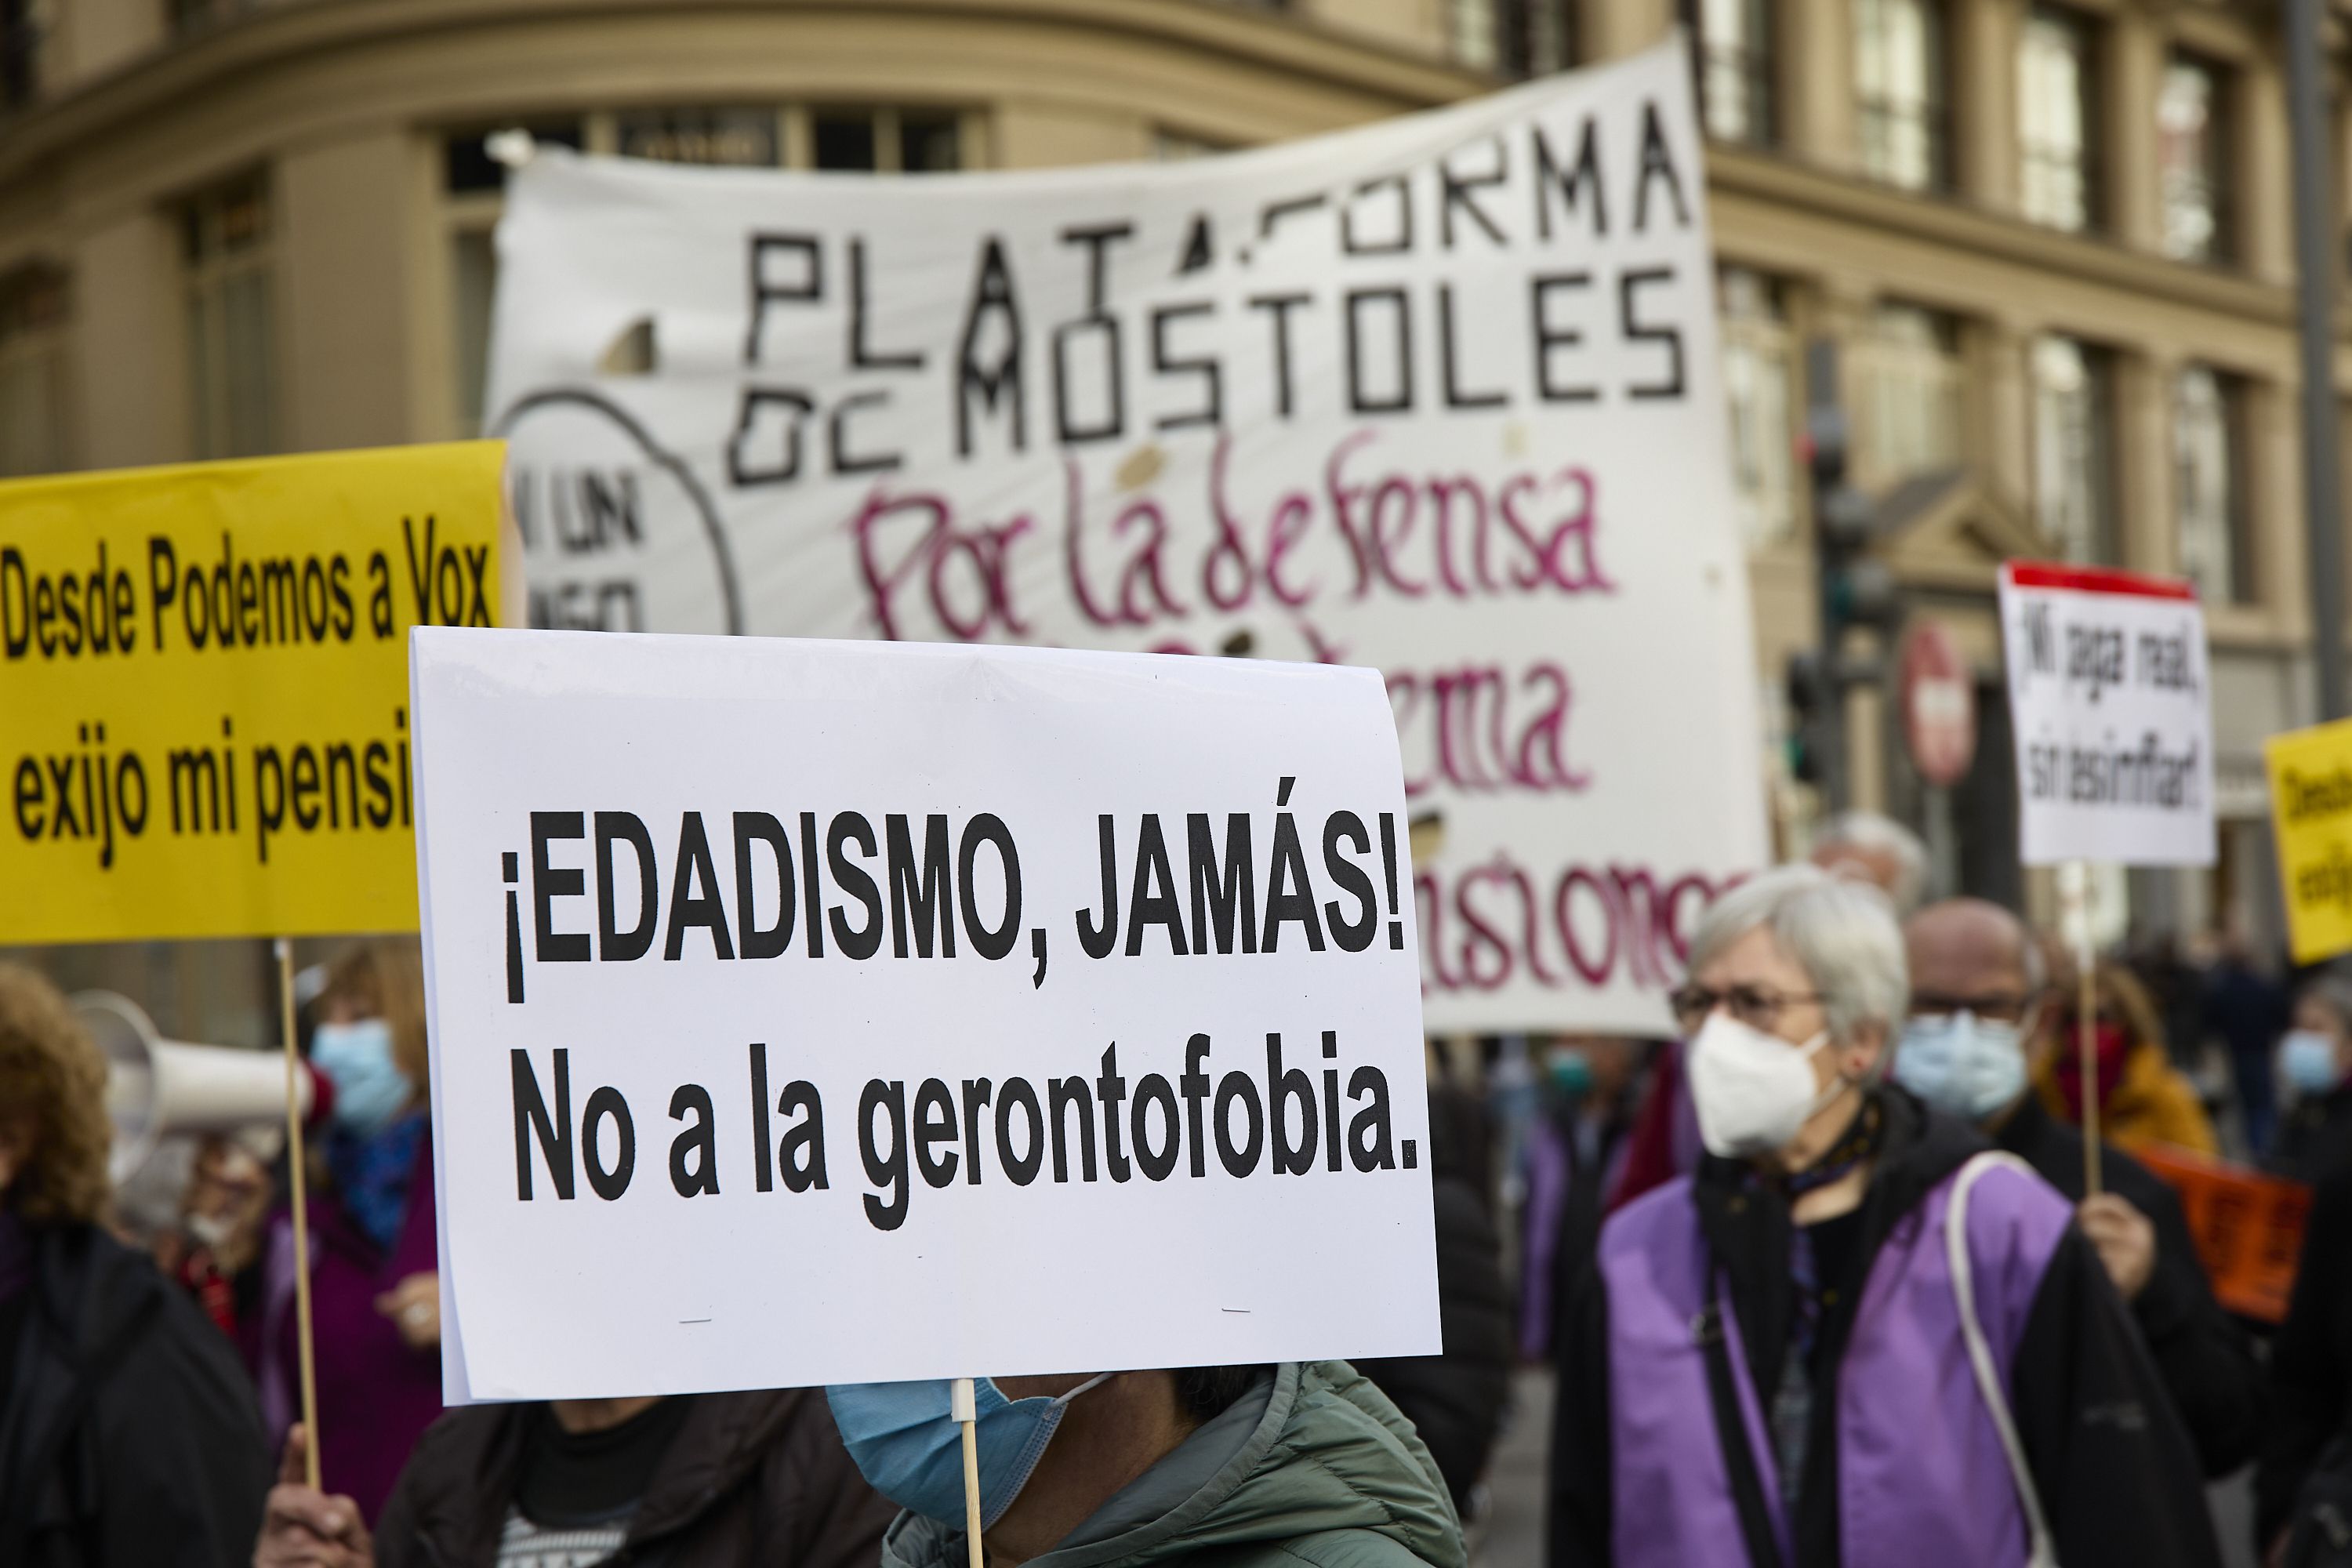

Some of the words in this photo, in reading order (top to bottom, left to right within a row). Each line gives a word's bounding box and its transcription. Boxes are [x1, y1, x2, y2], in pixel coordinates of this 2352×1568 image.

[1, 539, 136, 659] Desde
[147, 530, 355, 652] Podemos
[368, 550, 394, 639] a
[403, 514, 494, 627] Vox
[13, 720, 149, 871] exijo
[168, 716, 239, 835] mi
[254, 708, 411, 864] pensi
[503, 811, 1047, 1004] ¡EDADISMO,
[1076, 777, 1403, 959] JAMÁS!
[511, 1048, 635, 1200] No
[669, 1084, 720, 1198] a
[750, 1044, 829, 1192] la
[858, 1031, 1417, 1231] gerontofobia.
